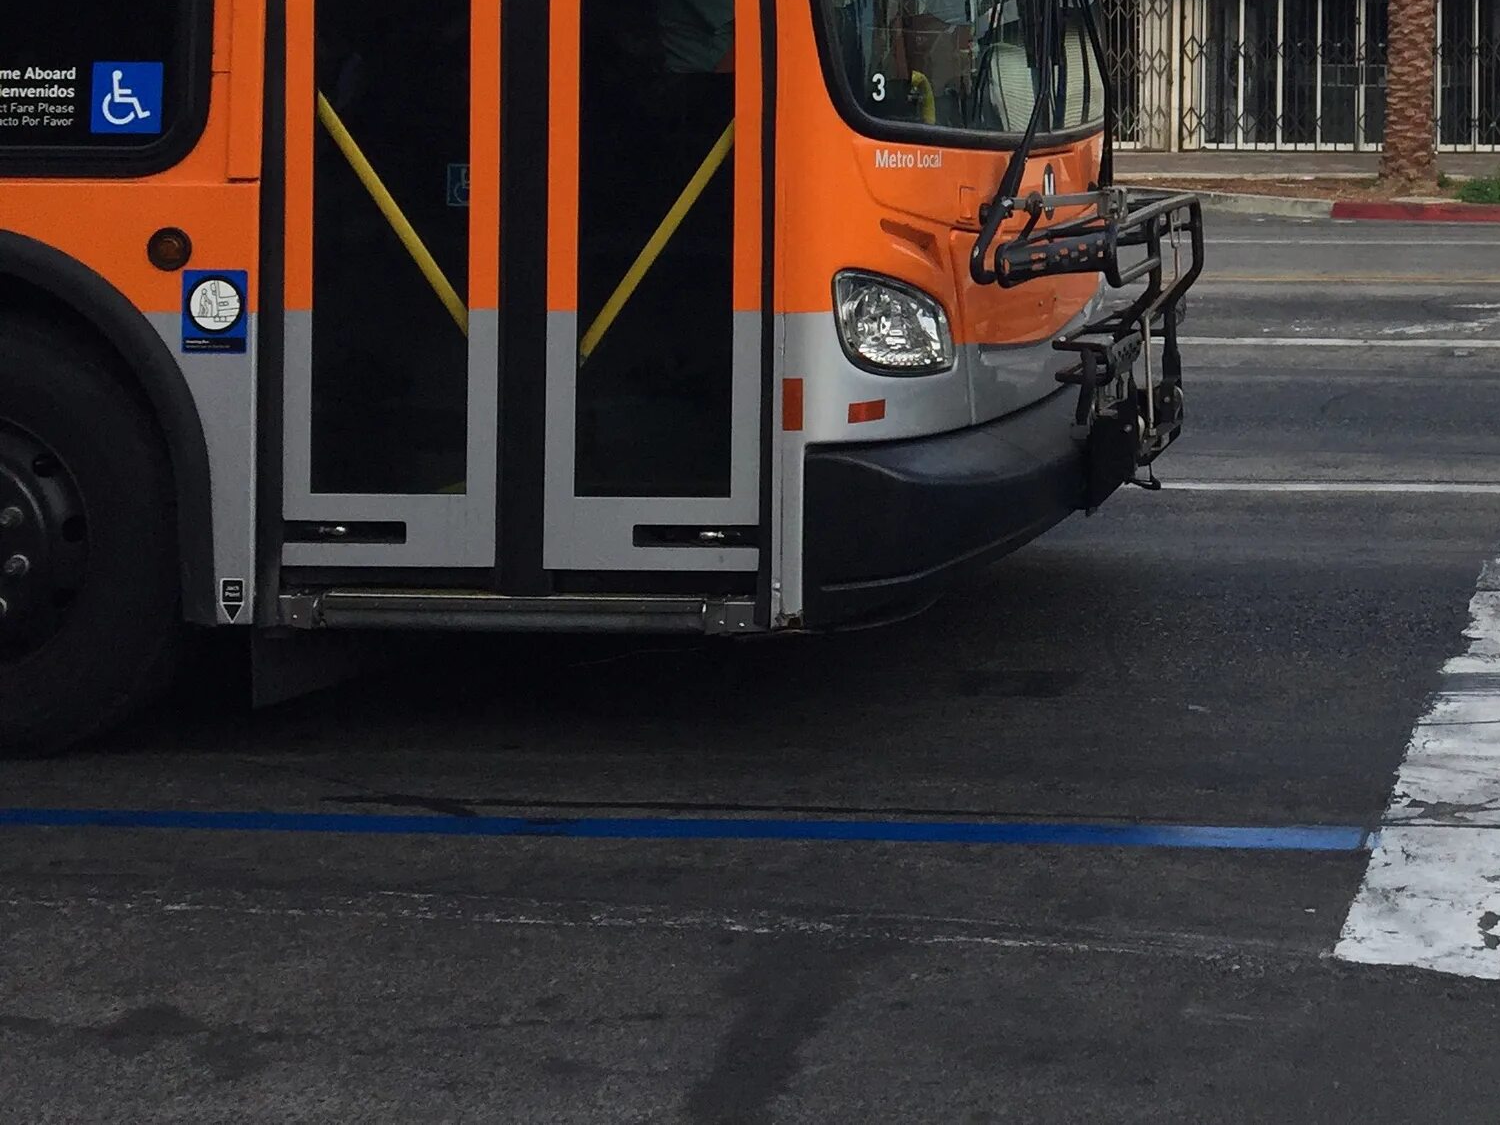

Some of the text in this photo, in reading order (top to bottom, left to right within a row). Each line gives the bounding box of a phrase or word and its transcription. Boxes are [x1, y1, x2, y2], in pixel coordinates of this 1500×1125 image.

[24, 66, 76, 80] Aboard
[872, 73, 886, 102] 3
[10, 102, 35, 113] Fare
[38, 102, 75, 113] Please
[22, 115, 40, 126] Por
[43, 115, 74, 126] Favor
[875, 149, 943, 168] Metro Local
